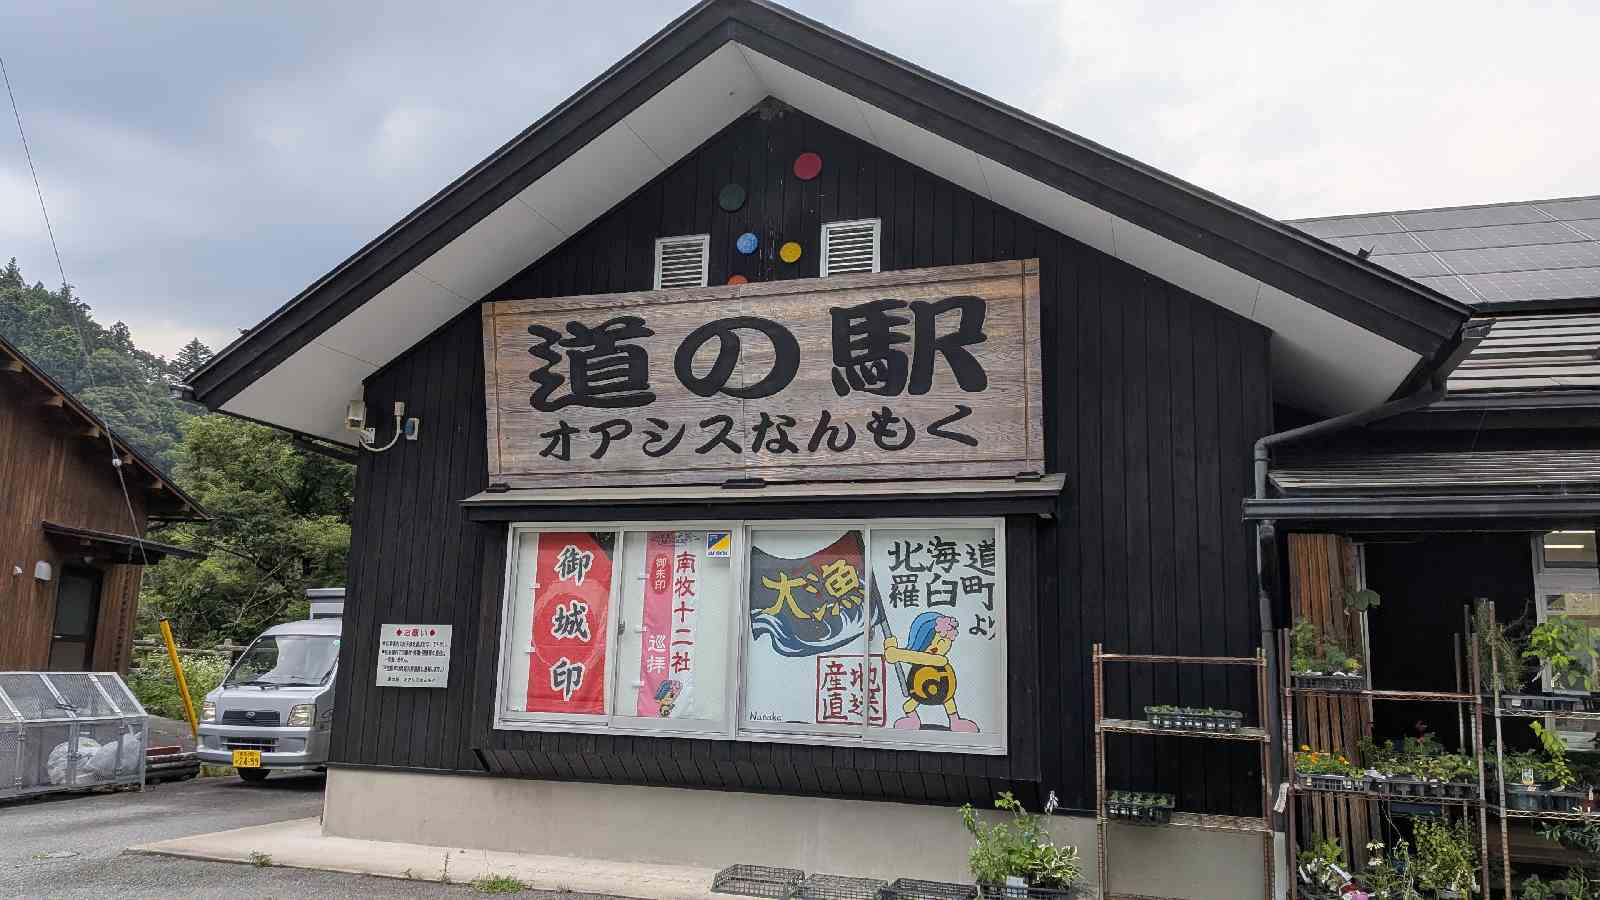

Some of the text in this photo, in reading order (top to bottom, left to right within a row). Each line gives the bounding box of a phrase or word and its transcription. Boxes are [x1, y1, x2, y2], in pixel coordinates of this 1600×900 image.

[527, 295, 989, 412] 道の駅
[538, 404, 979, 461] オアシスなんもく
[887, 535, 995, 576] 北海道
[671, 550, 697, 674] 南牧十二社
[761, 559, 865, 621] 大漁
[888, 573, 995, 611] 羅臼町
[550, 544, 595, 702] 御城印
